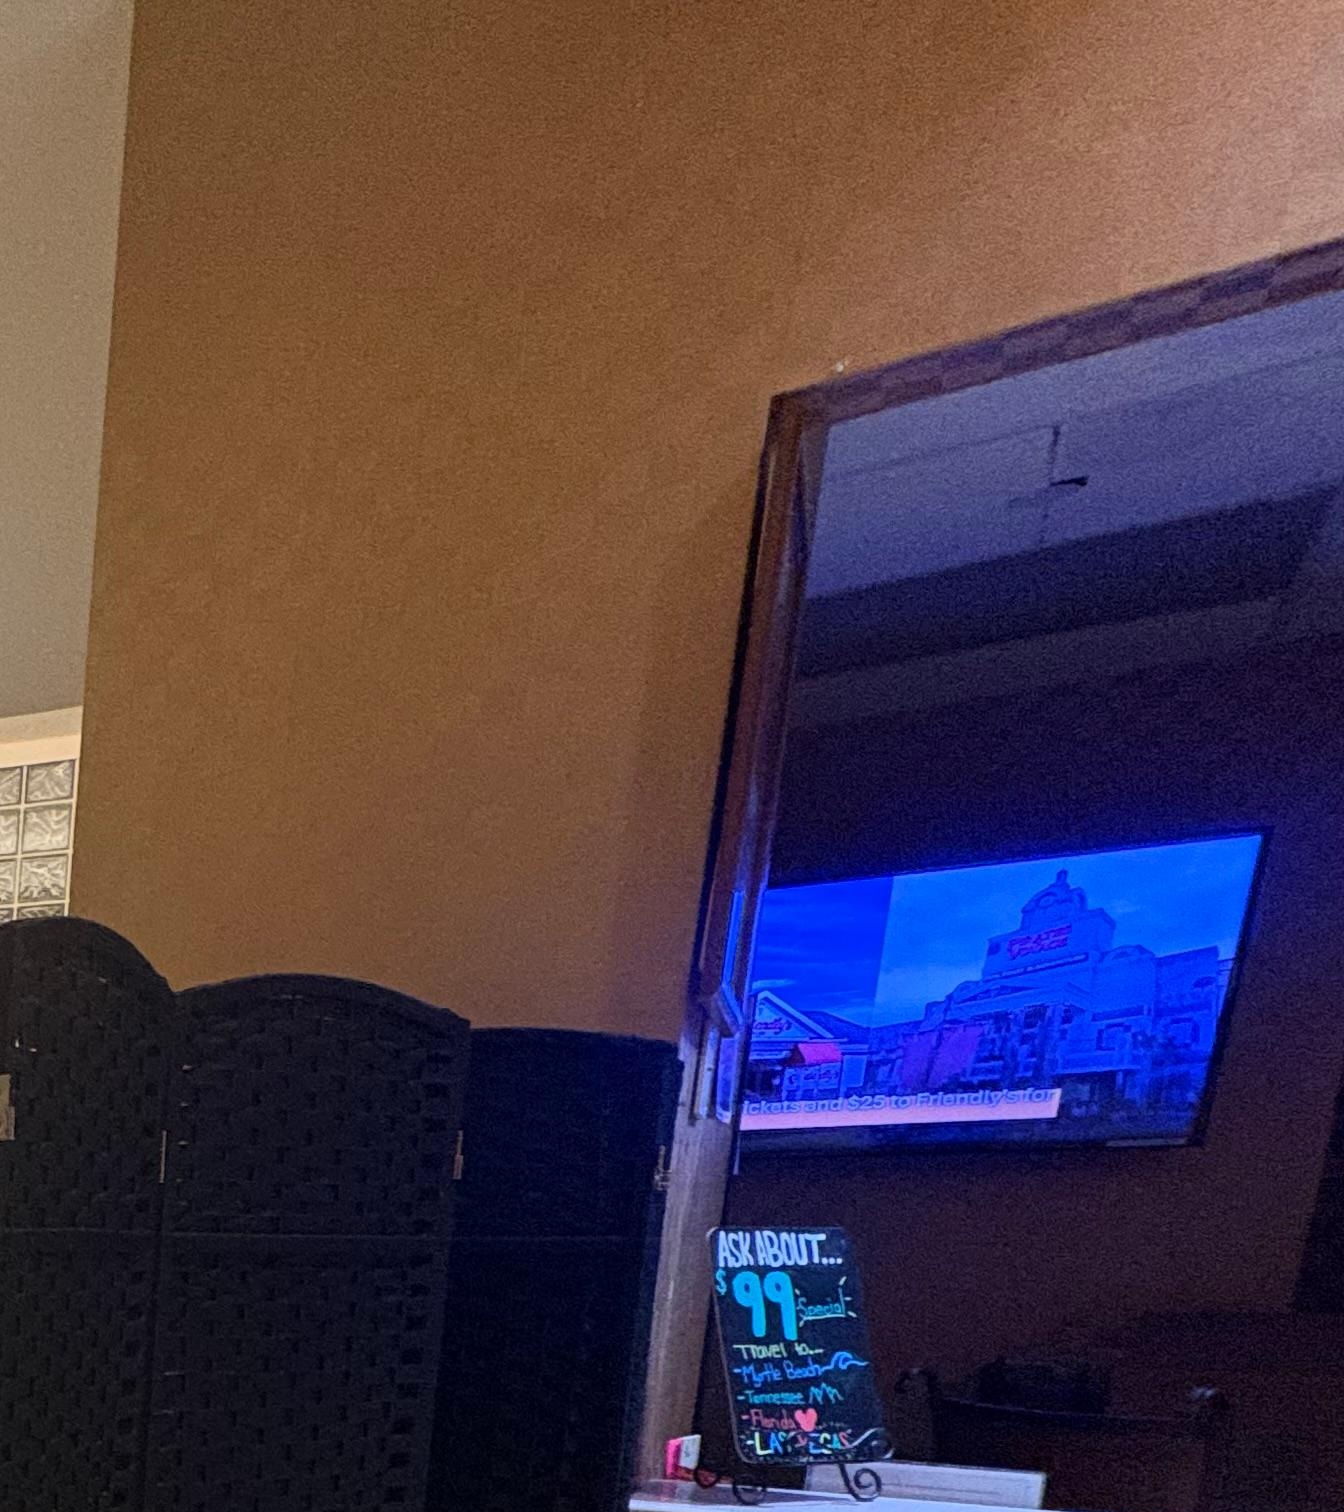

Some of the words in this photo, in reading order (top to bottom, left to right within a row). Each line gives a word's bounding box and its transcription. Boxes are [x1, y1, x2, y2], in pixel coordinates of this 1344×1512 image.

[804, 1096, 843, 1113] and
[847, 1094, 886, 1112] $25
[890, 1094, 911, 1109] to
[915, 1088, 1020, 1111] Friendly's
[1022, 1086, 1055, 1102] for
[717, 1230, 755, 1268] ASK
[733, 1342, 788, 1360] Travel
